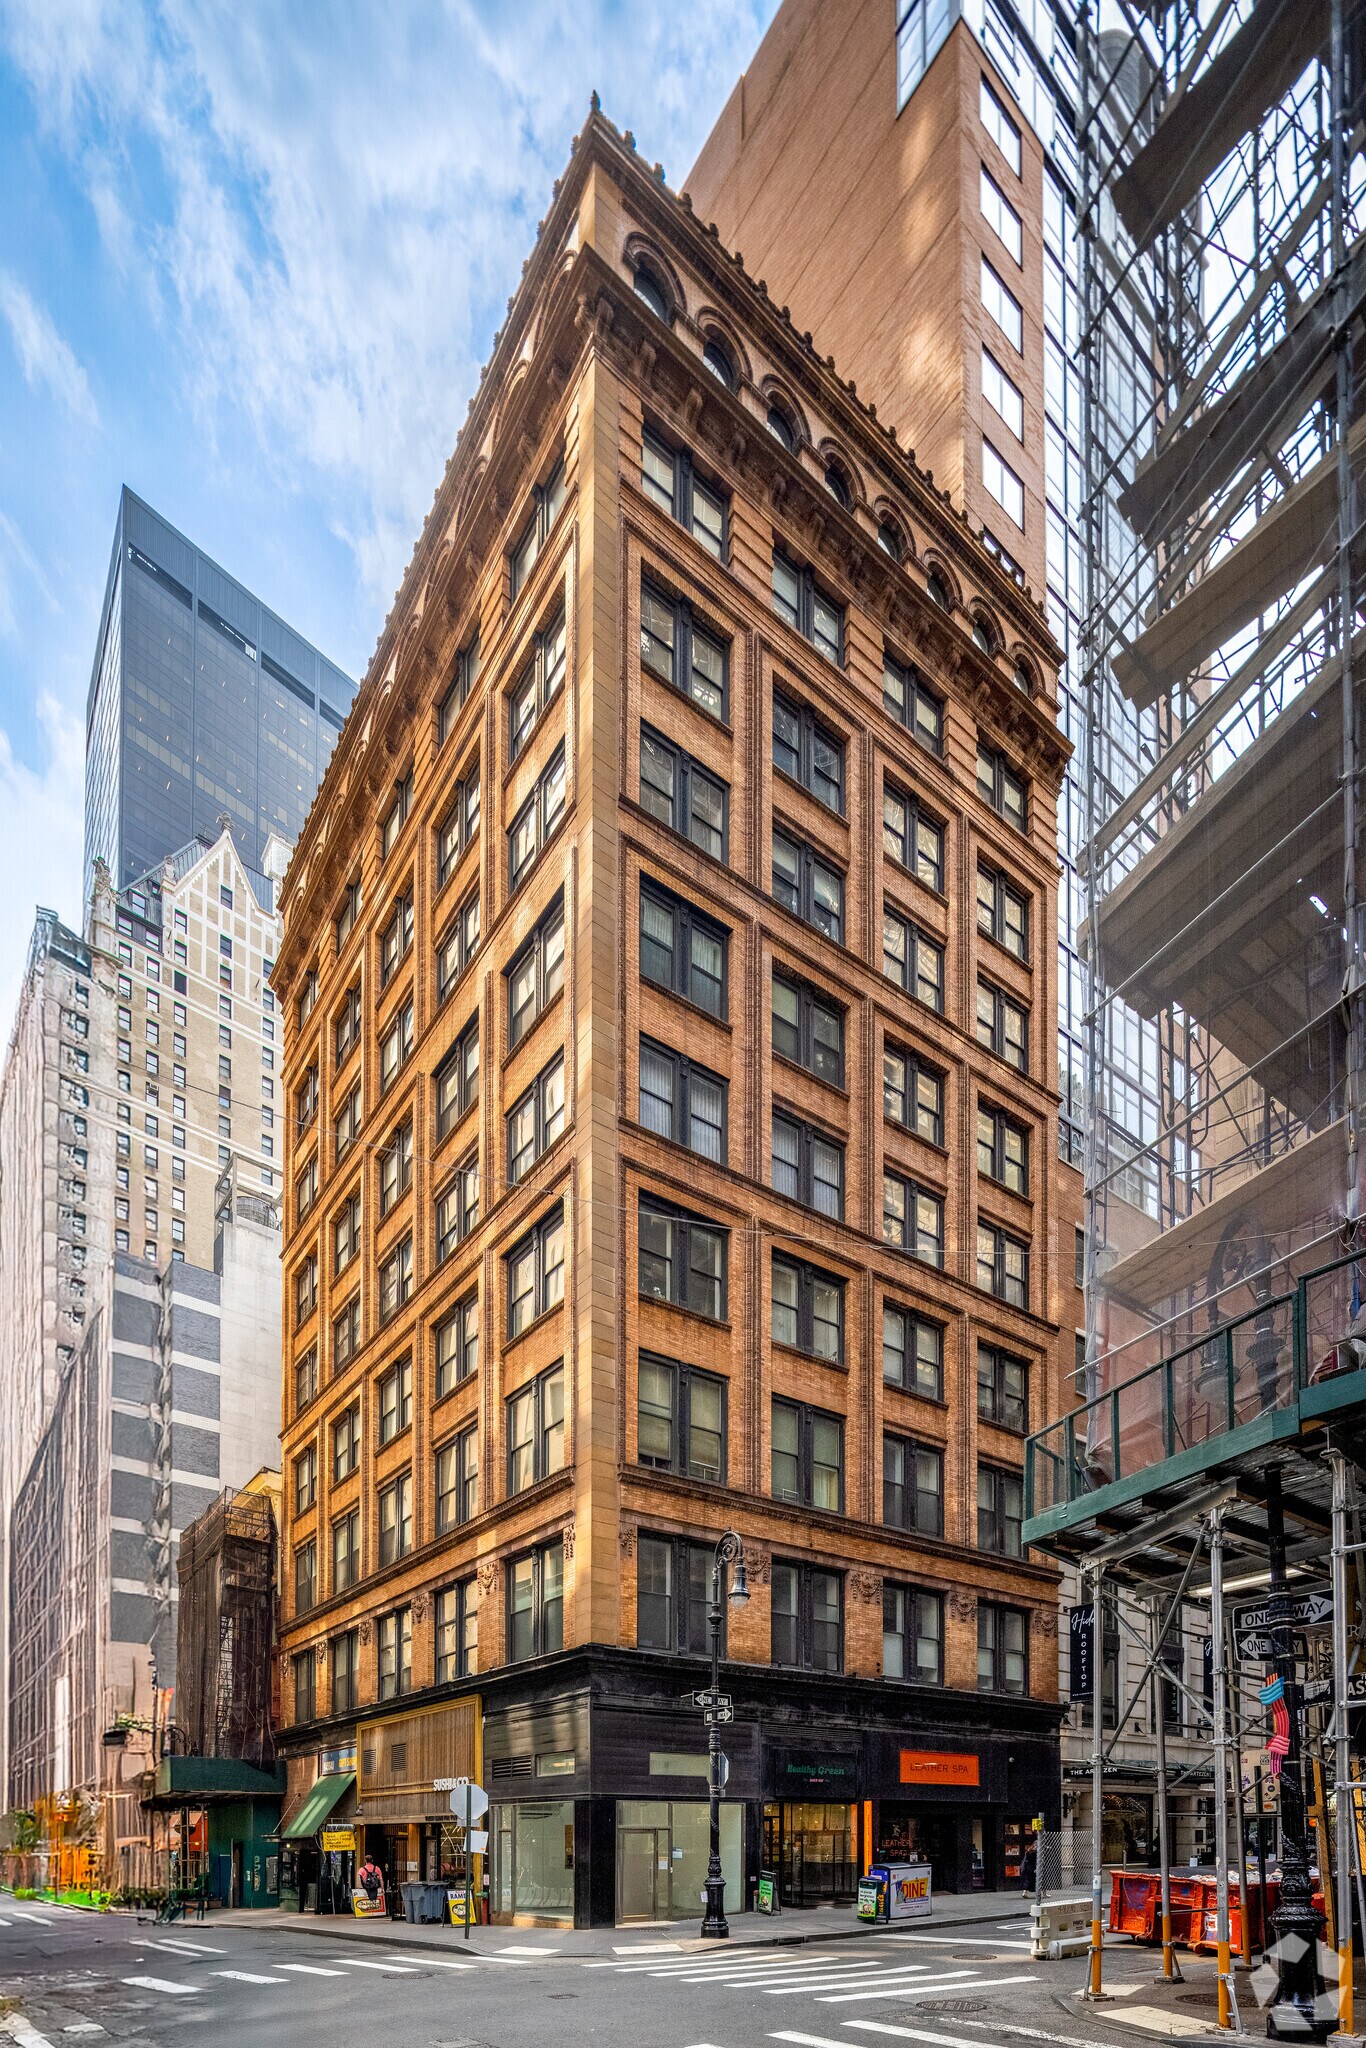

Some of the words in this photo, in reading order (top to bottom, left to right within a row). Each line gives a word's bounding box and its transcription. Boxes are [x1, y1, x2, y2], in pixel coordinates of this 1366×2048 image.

[1294, 1601, 1325, 1617] WAY
[1247, 1641, 1267, 1652] ONE
[1347, 1681, 1366, 1696] AS
[787, 1764, 816, 1776] Healthy
[817, 1766, 845, 1775] Green
[910, 1763, 948, 1773] LEATHER
[952, 1765, 969, 1773] SPA
